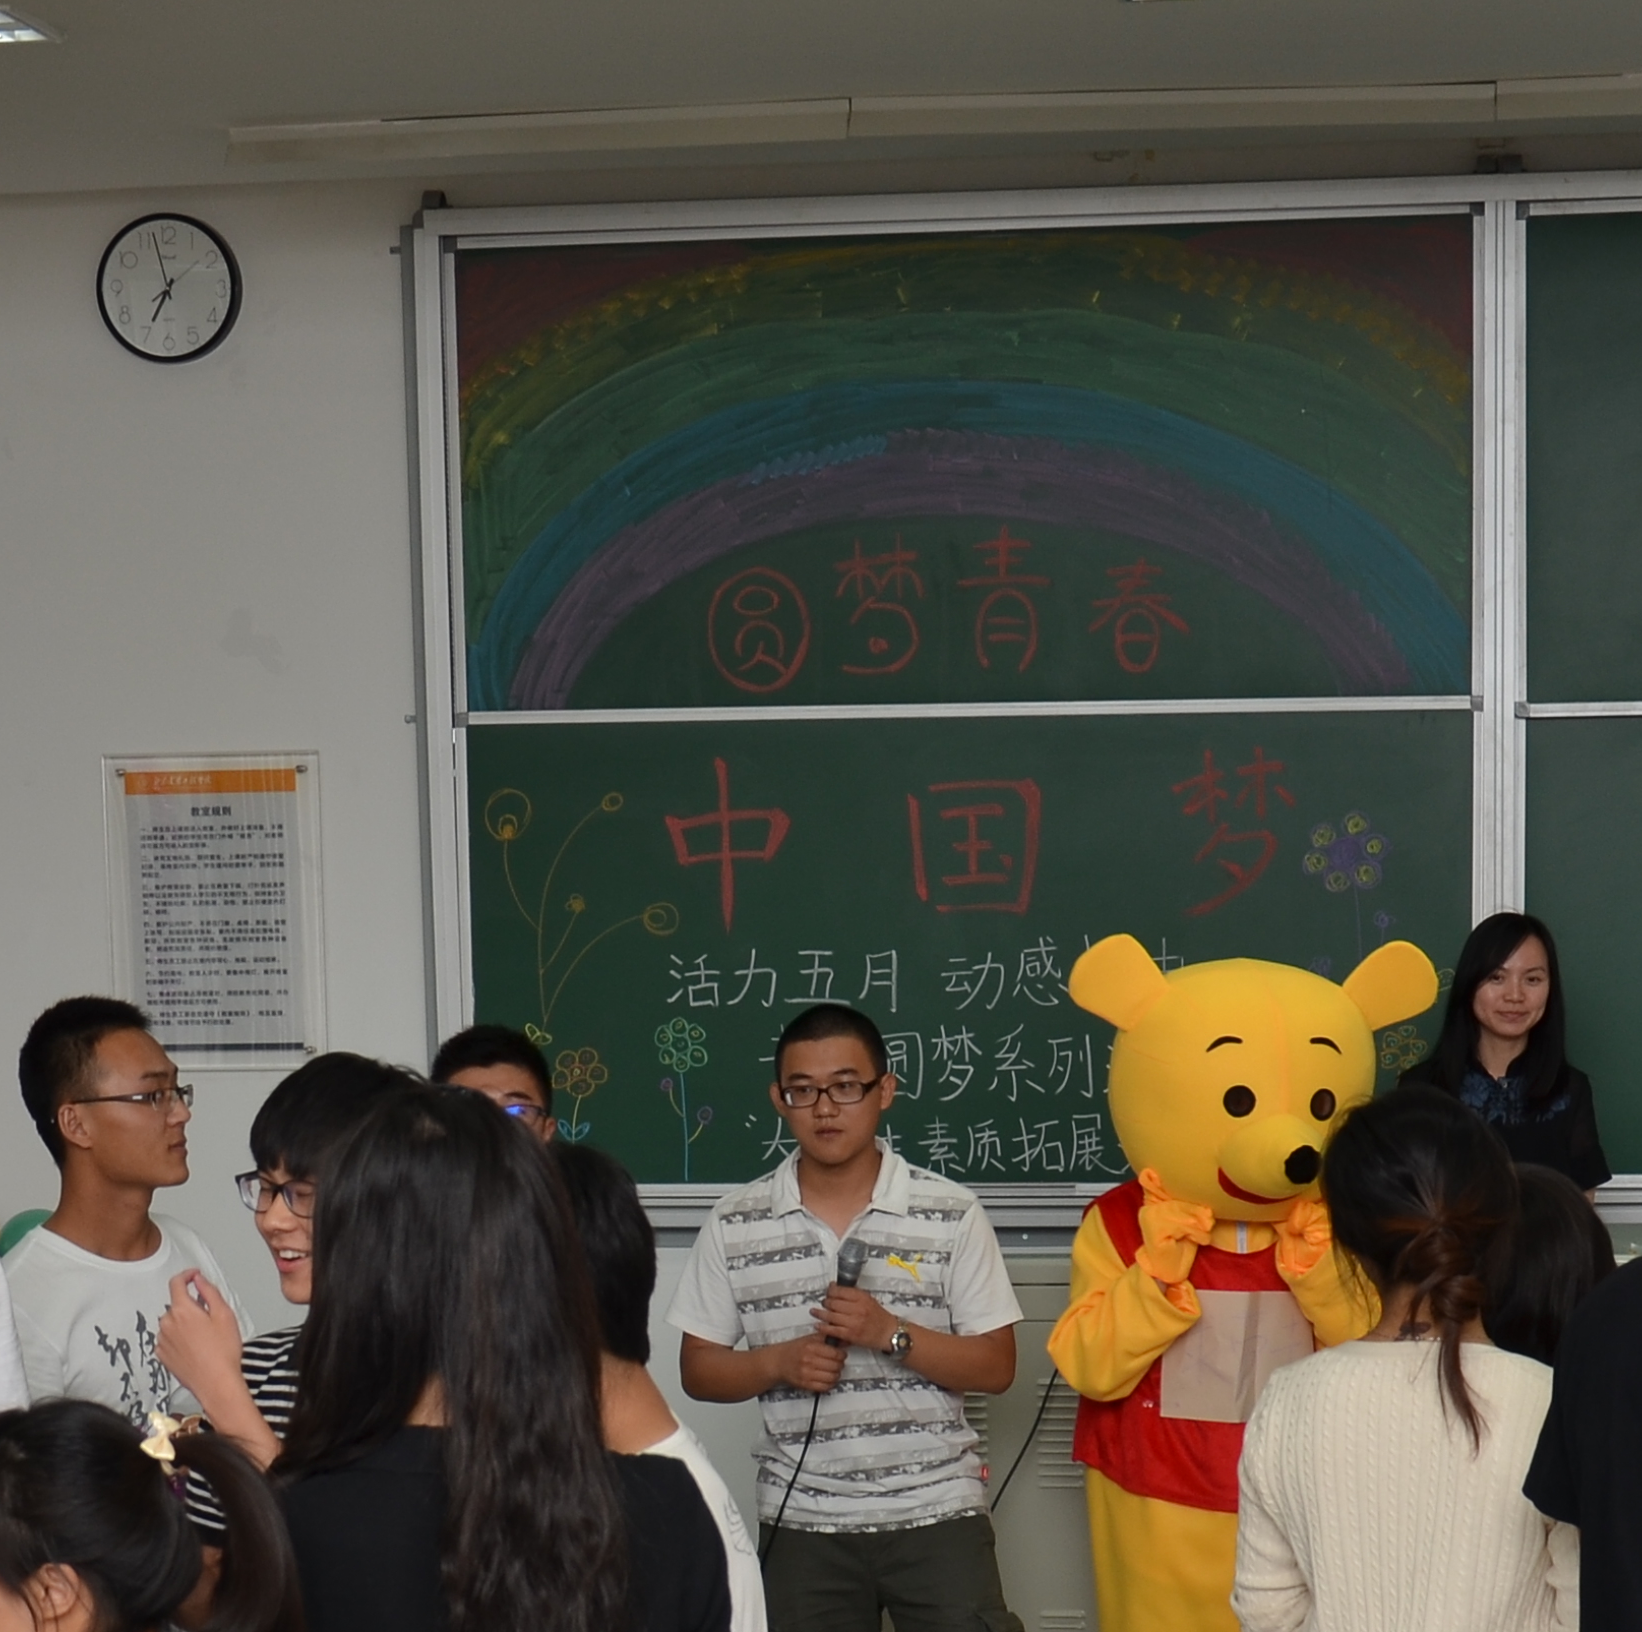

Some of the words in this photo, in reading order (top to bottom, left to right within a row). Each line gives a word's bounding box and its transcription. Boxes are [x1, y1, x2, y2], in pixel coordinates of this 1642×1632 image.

[138, 231, 150, 249] 11
[161, 226, 176, 244] 12
[119, 251, 138, 269] 10
[205, 250, 218, 269] 2
[111, 279, 123, 297] 9
[216, 279, 227, 298] 3
[119, 305, 131, 324] 8
[207, 307, 217, 323] 4
[140, 326, 151, 343] 7
[163, 333, 175, 350] 6
[187, 327, 199, 345] 5
[665, 746, 1296, 935] 中国梦
[666, 948, 899, 1013] 活力五月
